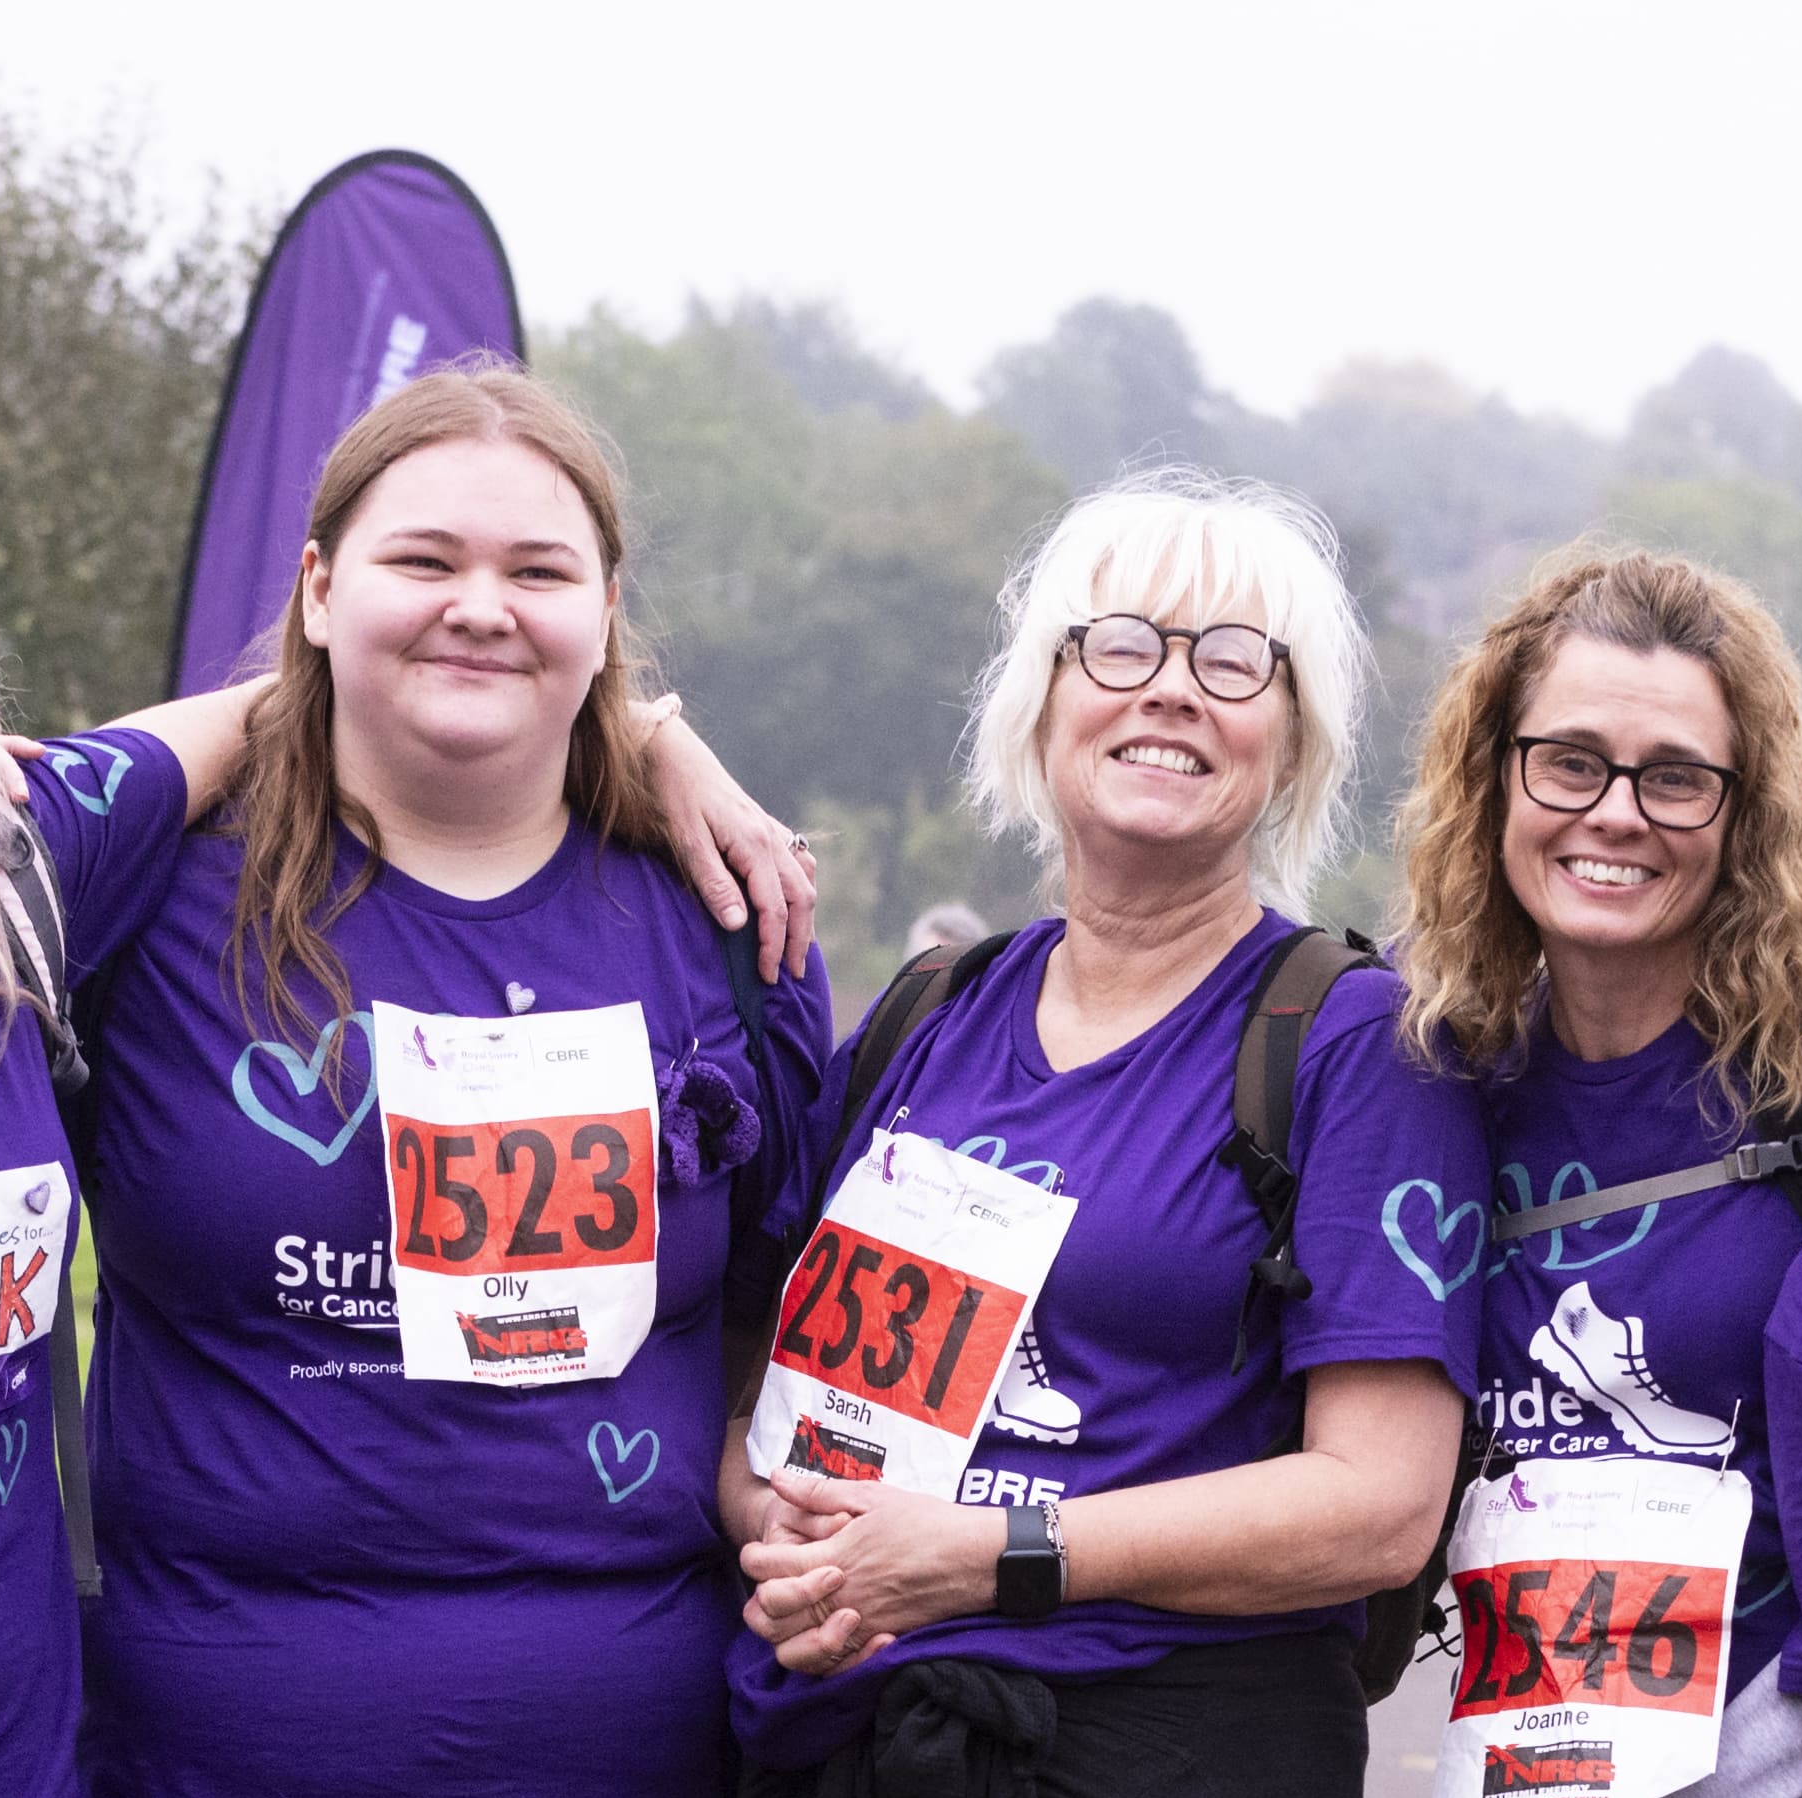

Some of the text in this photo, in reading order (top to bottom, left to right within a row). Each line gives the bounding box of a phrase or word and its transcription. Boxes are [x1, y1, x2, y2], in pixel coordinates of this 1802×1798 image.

[545, 1049, 590, 1063] CBRE
[396, 1123, 639, 1262] 2523
[969, 1204, 1013, 1230] CBRE
[482, 1276, 529, 1302] Olly
[277, 1292, 315, 1315] for
[778, 1231, 985, 1411] 2531
[290, 1360, 345, 1380] Proudly
[824, 1389, 872, 1426] Sarah
[1549, 1432, 1610, 1455] Care
[1645, 1499, 1692, 1515] CBRE
[1464, 1570, 1697, 1705] 2546
[1513, 1709, 1590, 1733] Joanne
